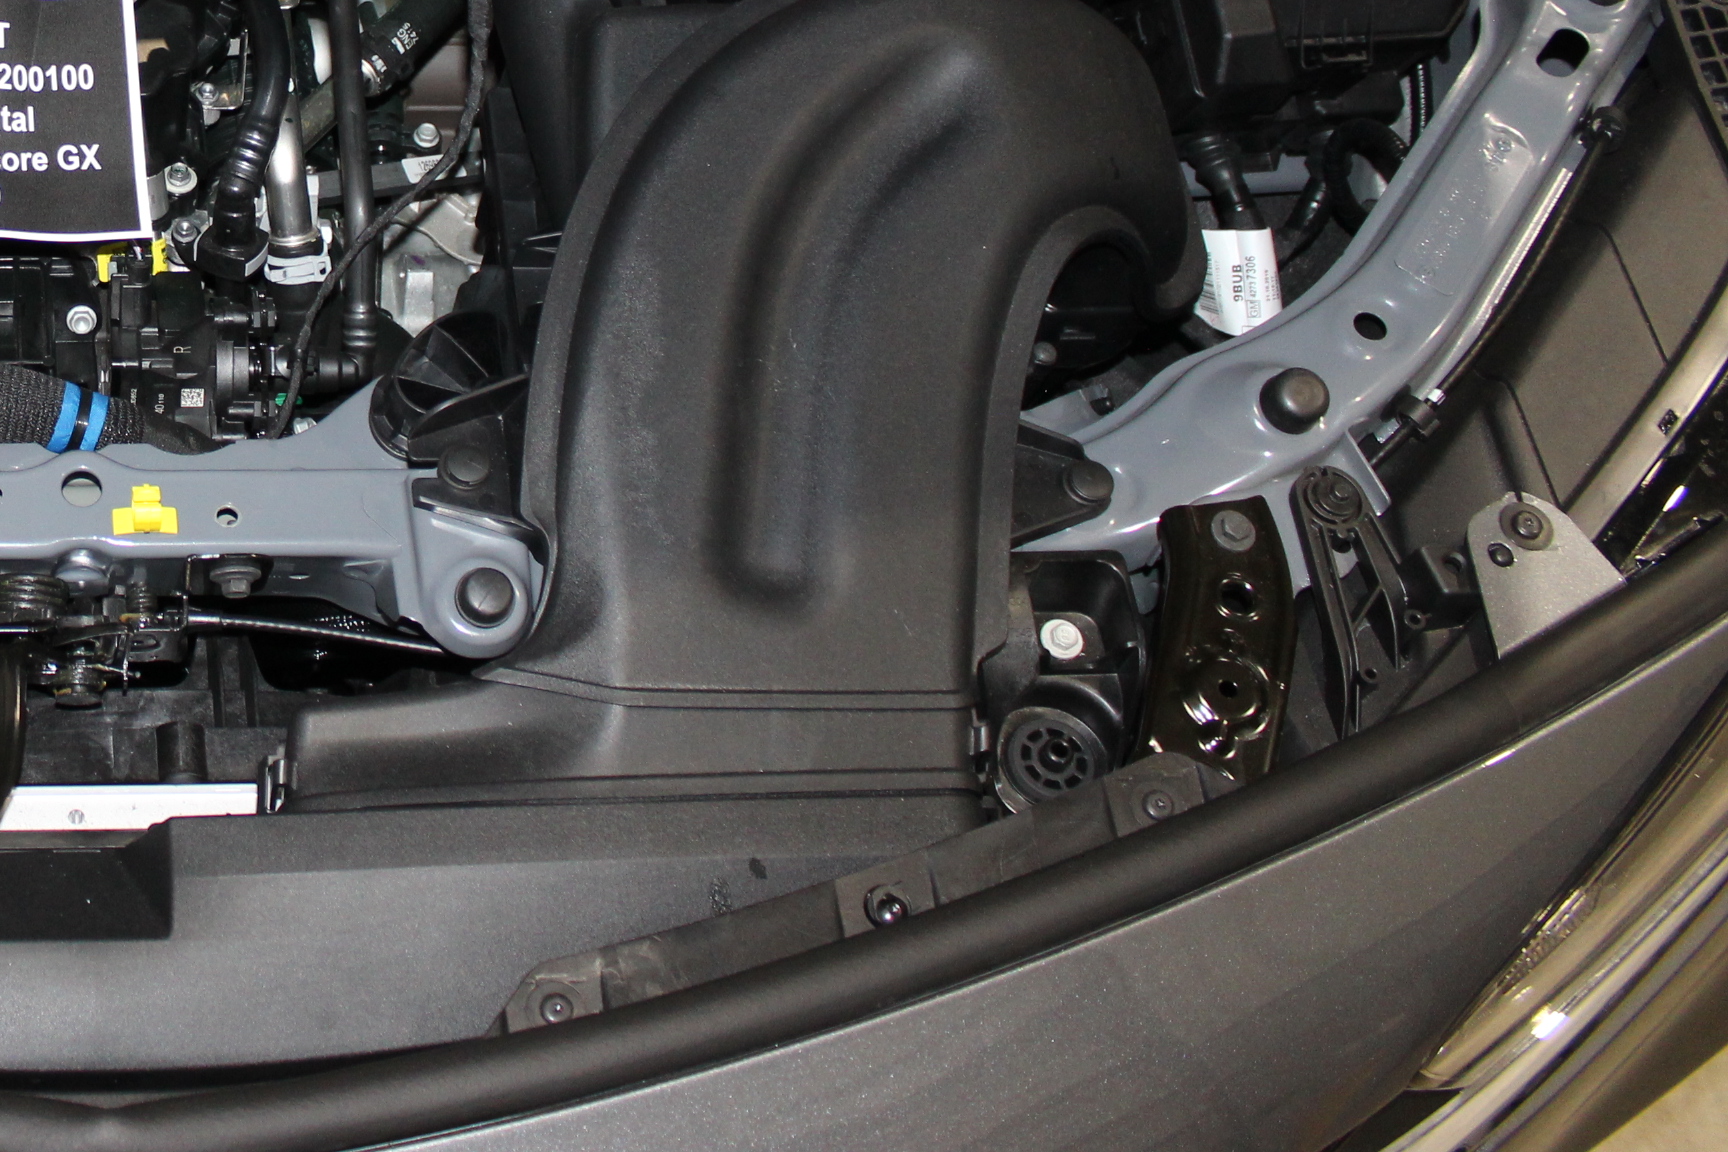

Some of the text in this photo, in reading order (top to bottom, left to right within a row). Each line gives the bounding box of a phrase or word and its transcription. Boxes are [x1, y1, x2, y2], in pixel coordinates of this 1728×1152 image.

[57, 144, 101, 170] GX
[1232, 264, 1243, 302] 9BUB
[173, 346, 191, 354] R
